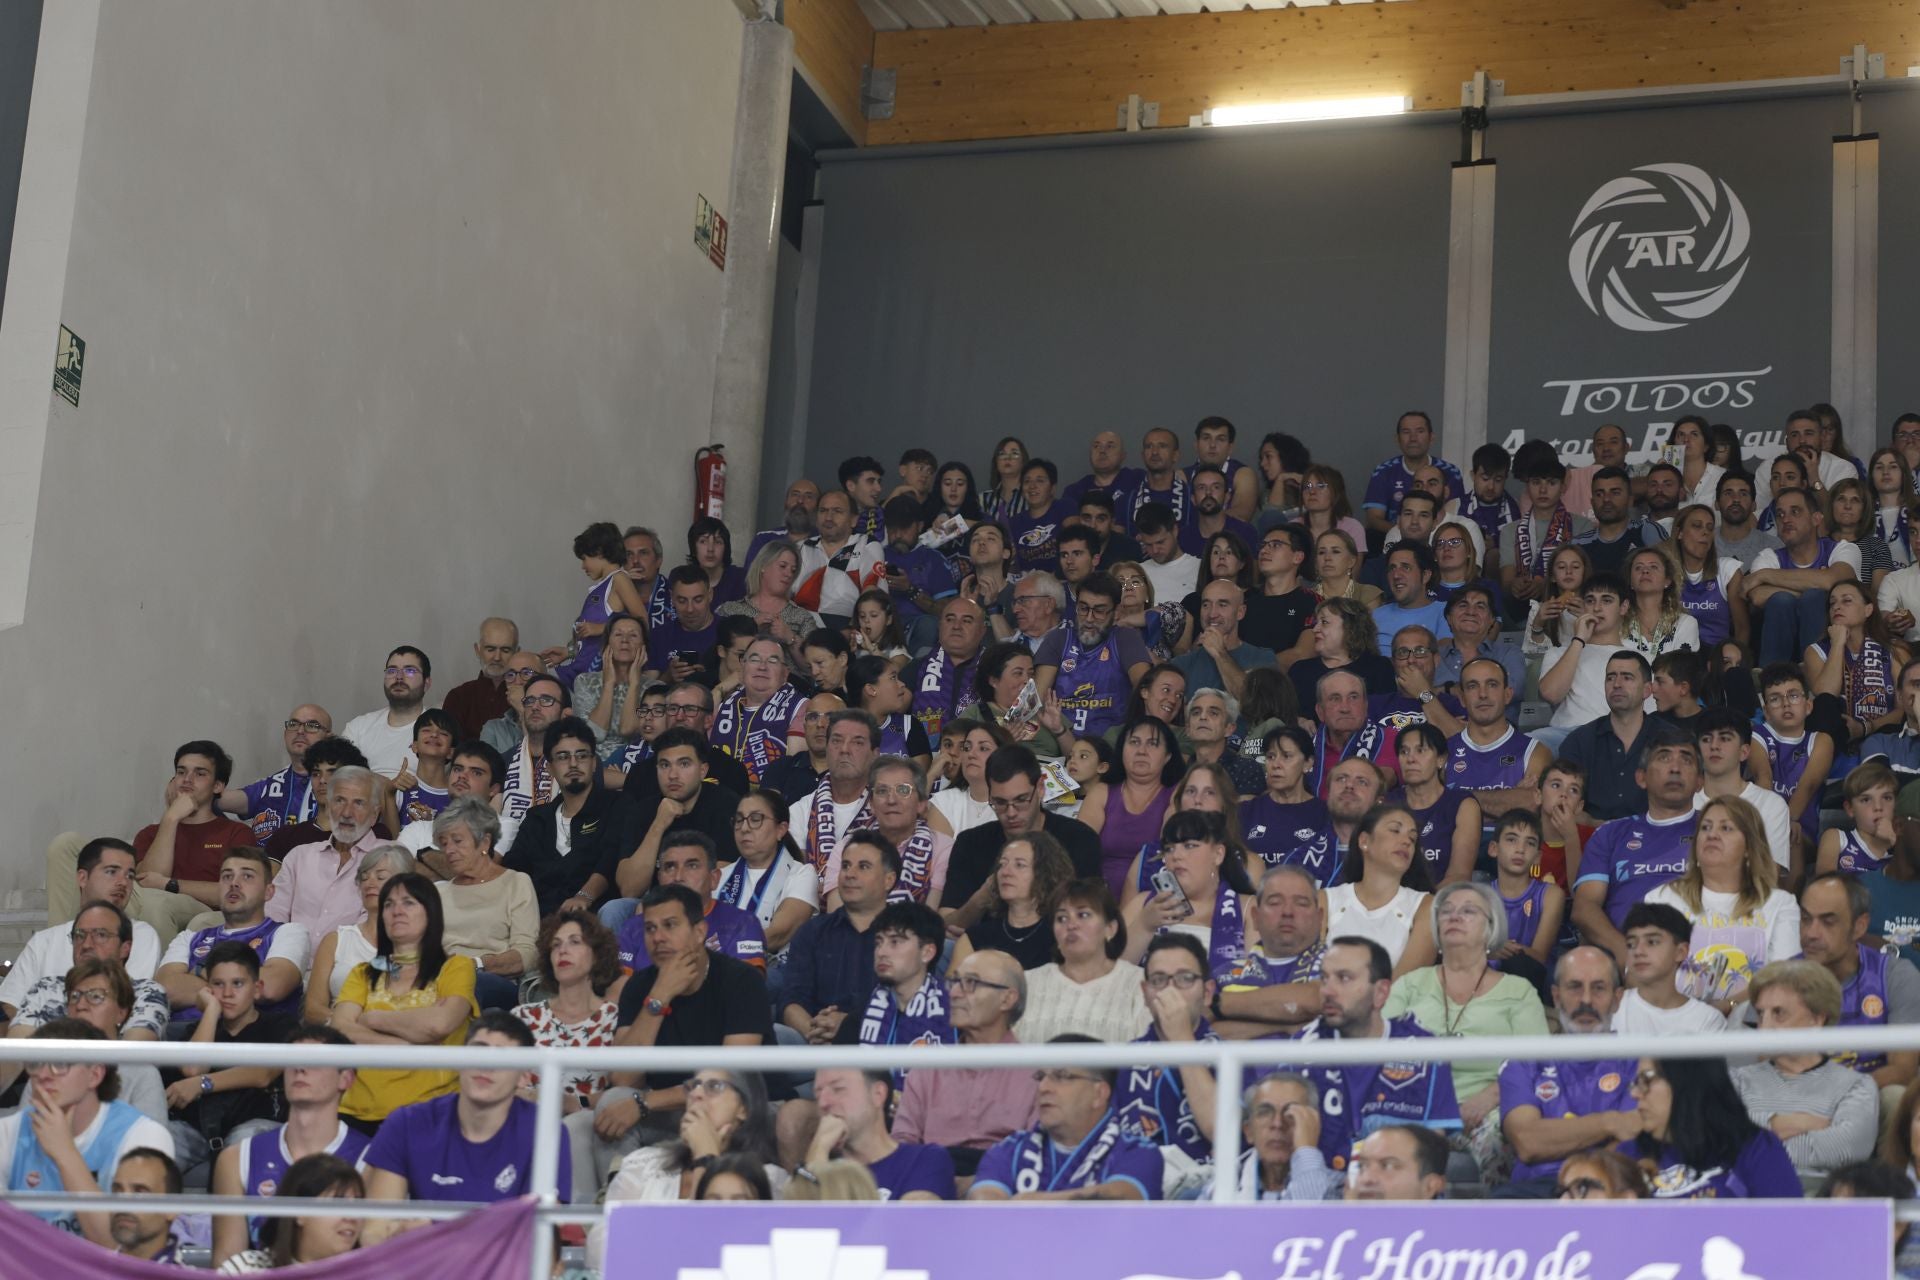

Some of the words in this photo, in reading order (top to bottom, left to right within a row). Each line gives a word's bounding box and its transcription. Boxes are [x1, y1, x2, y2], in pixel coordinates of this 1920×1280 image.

[1681, 599, 1718, 611] under
[748, 733, 769, 768] ENCIA
[1633, 858, 1688, 875] zund
[1272, 1229, 1357, 1280] El
[1361, 1229, 1528, 1280] Horno
[1533, 1230, 1593, 1280] de
